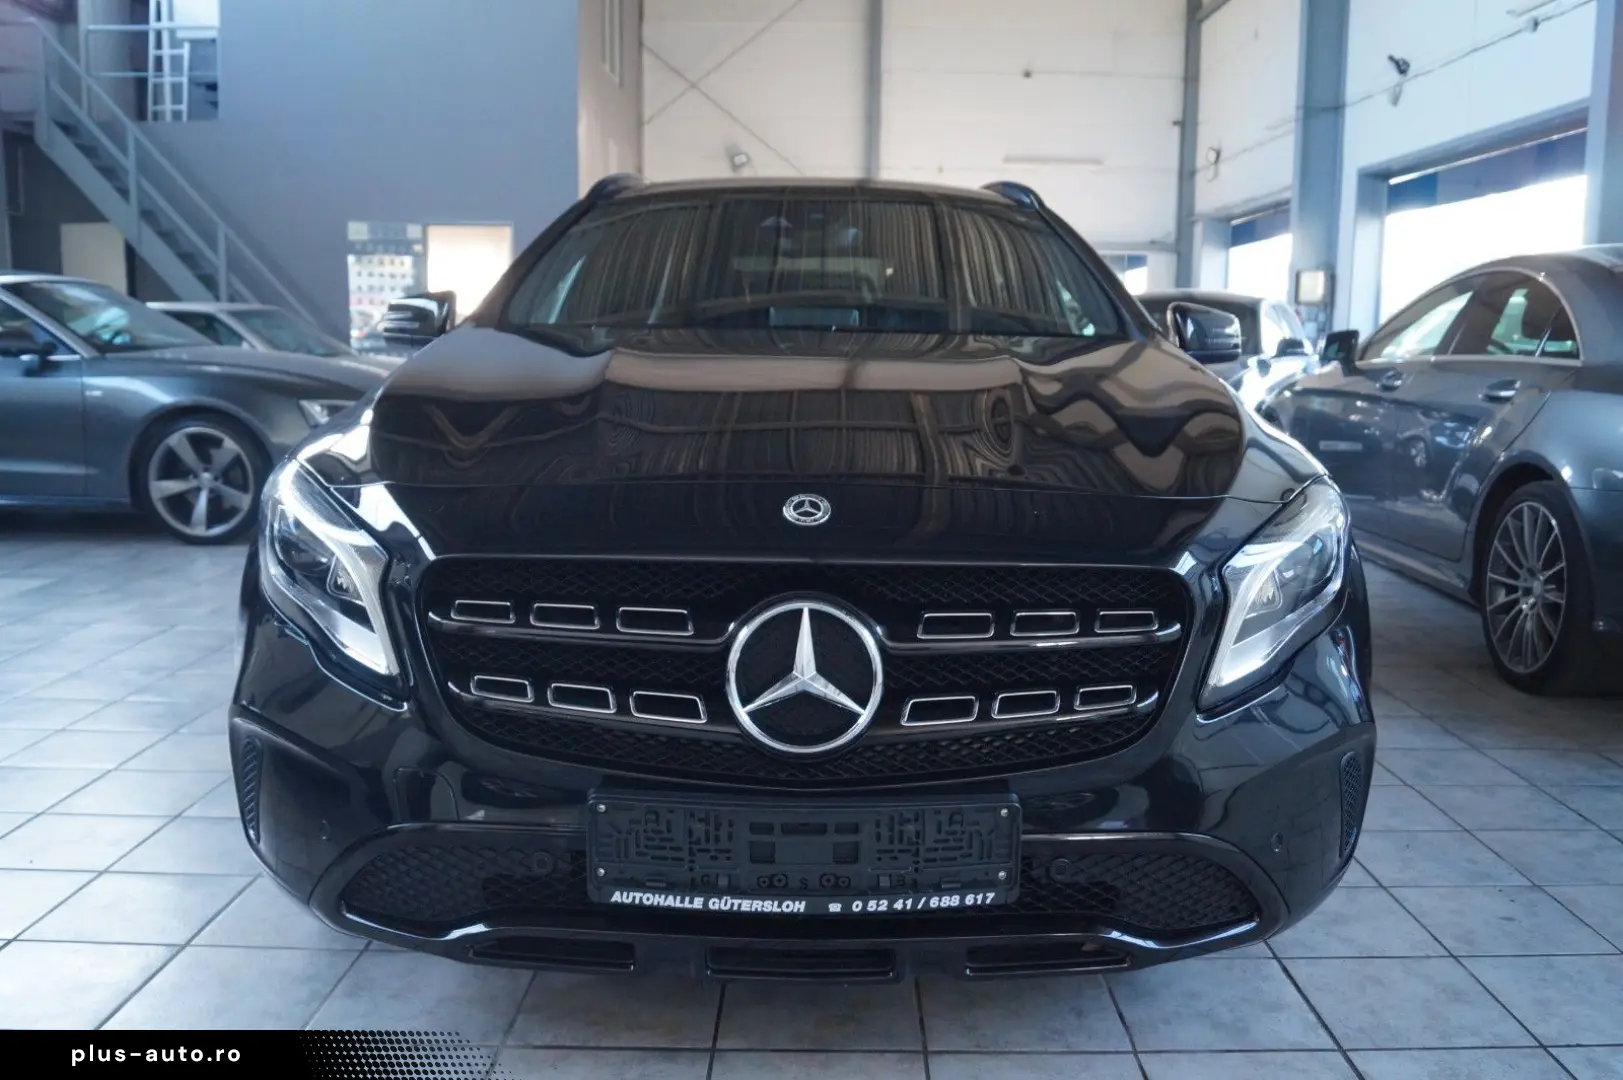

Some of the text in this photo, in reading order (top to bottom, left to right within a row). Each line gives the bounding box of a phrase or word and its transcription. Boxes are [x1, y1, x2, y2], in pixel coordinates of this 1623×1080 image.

[610, 890, 705, 910] AUTOHALLE
[708, 895, 807, 914] GÜTERSLOH
[851, 900, 863, 913] 0
[866, 899, 890, 913] 52
[892, 897, 912, 911] 41
[929, 894, 962, 908] 688
[964, 891, 997, 906] 617
